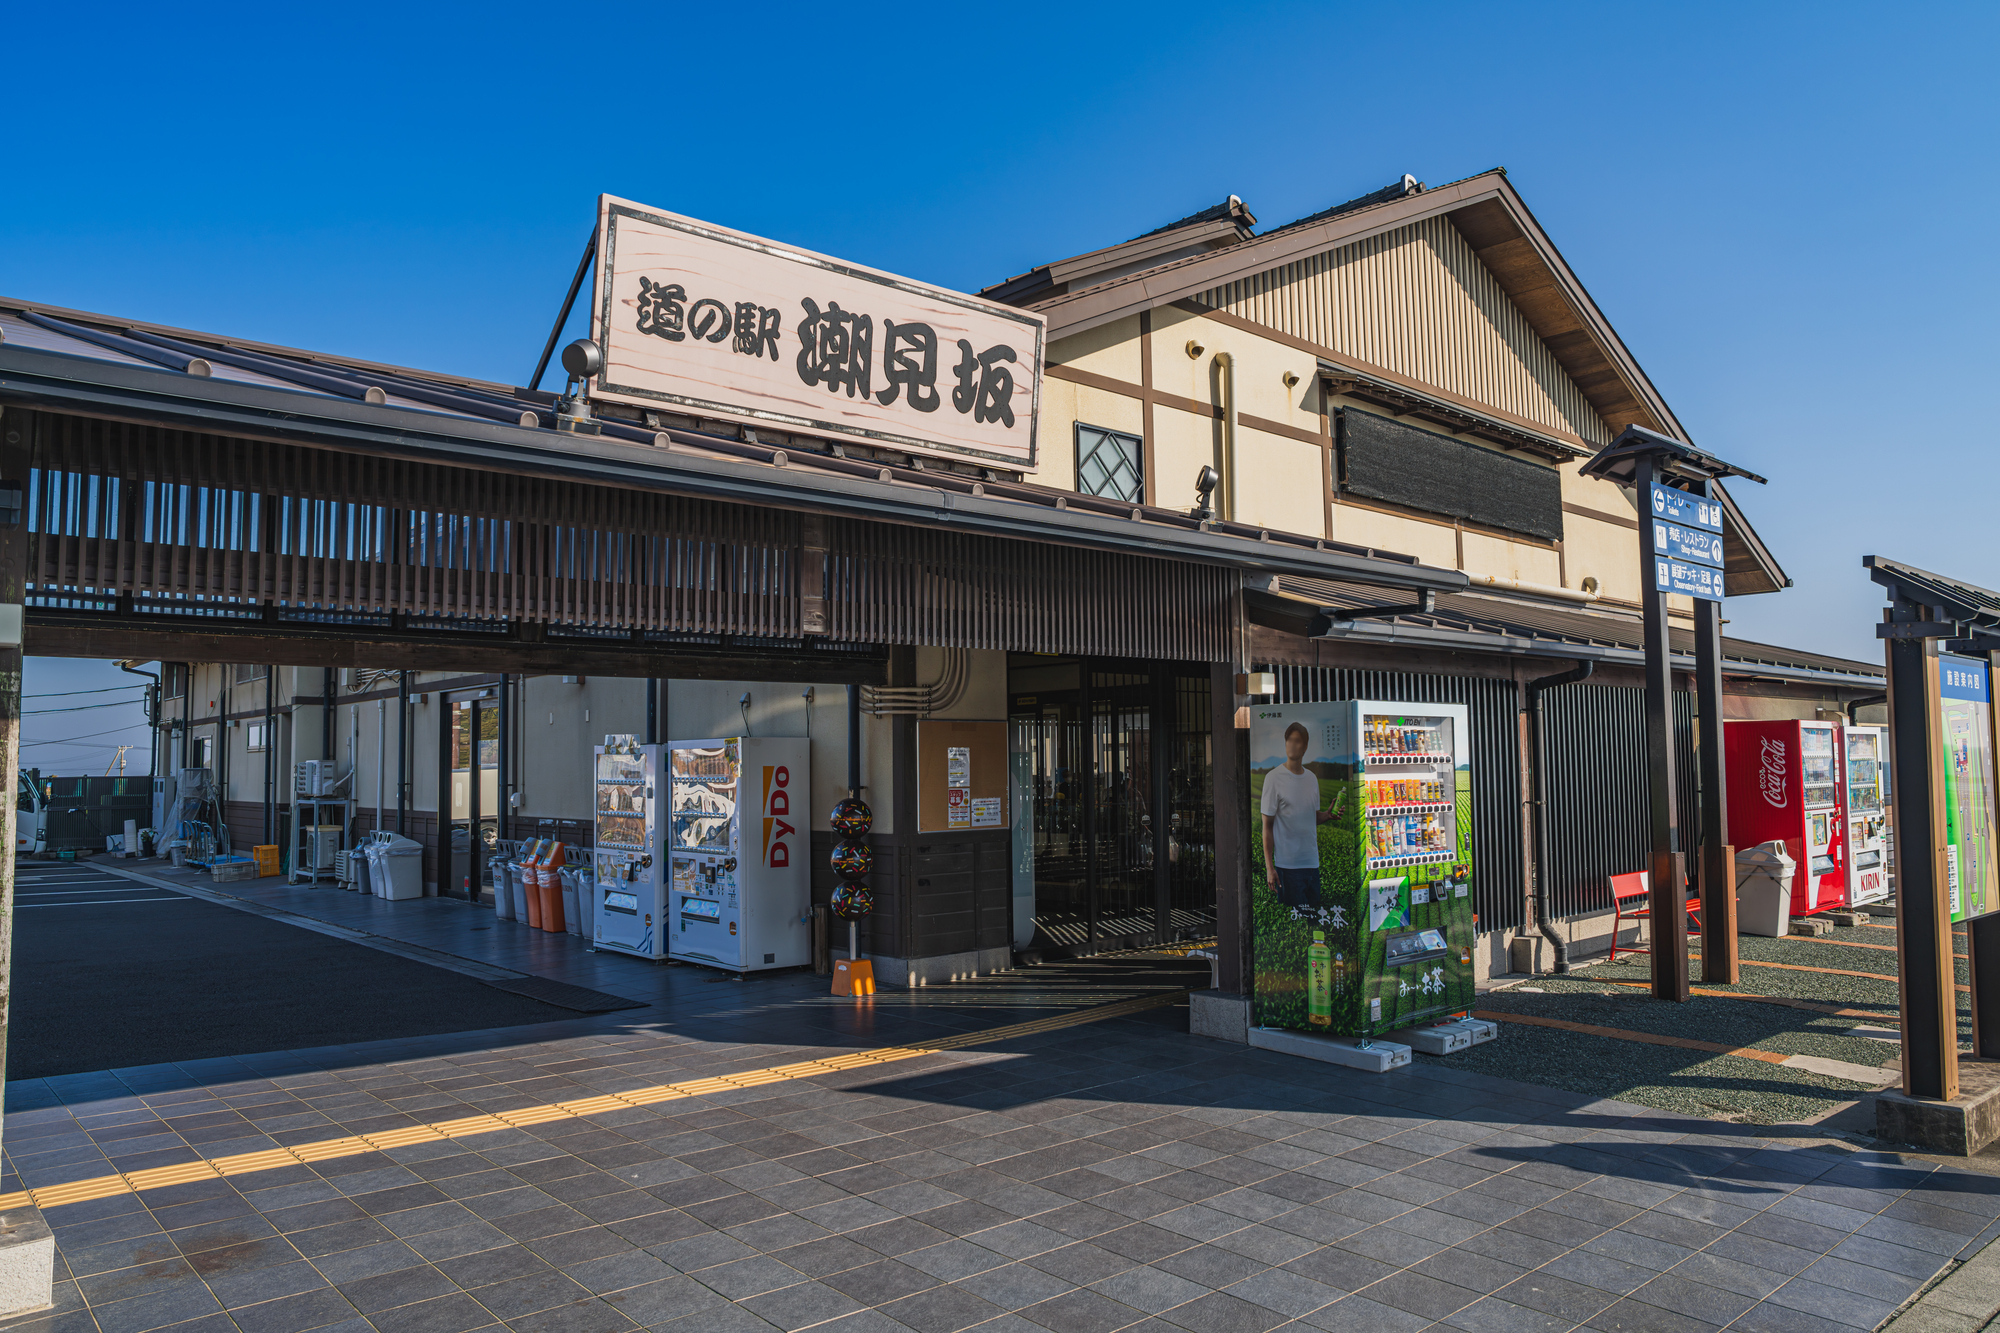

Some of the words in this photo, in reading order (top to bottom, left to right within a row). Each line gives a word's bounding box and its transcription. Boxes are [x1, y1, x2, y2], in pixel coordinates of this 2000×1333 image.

[636, 276, 781, 362] 道の駅
[797, 297, 1018, 429] 潮見坂
[1666, 490, 1685, 507] トイレ
[1947, 669, 1980, 690] 施設案内図
[1761, 735, 1787, 809] Coca-Cola
[770, 765, 796, 868] DyDo
[1860, 872, 1880, 892] KIRIN
